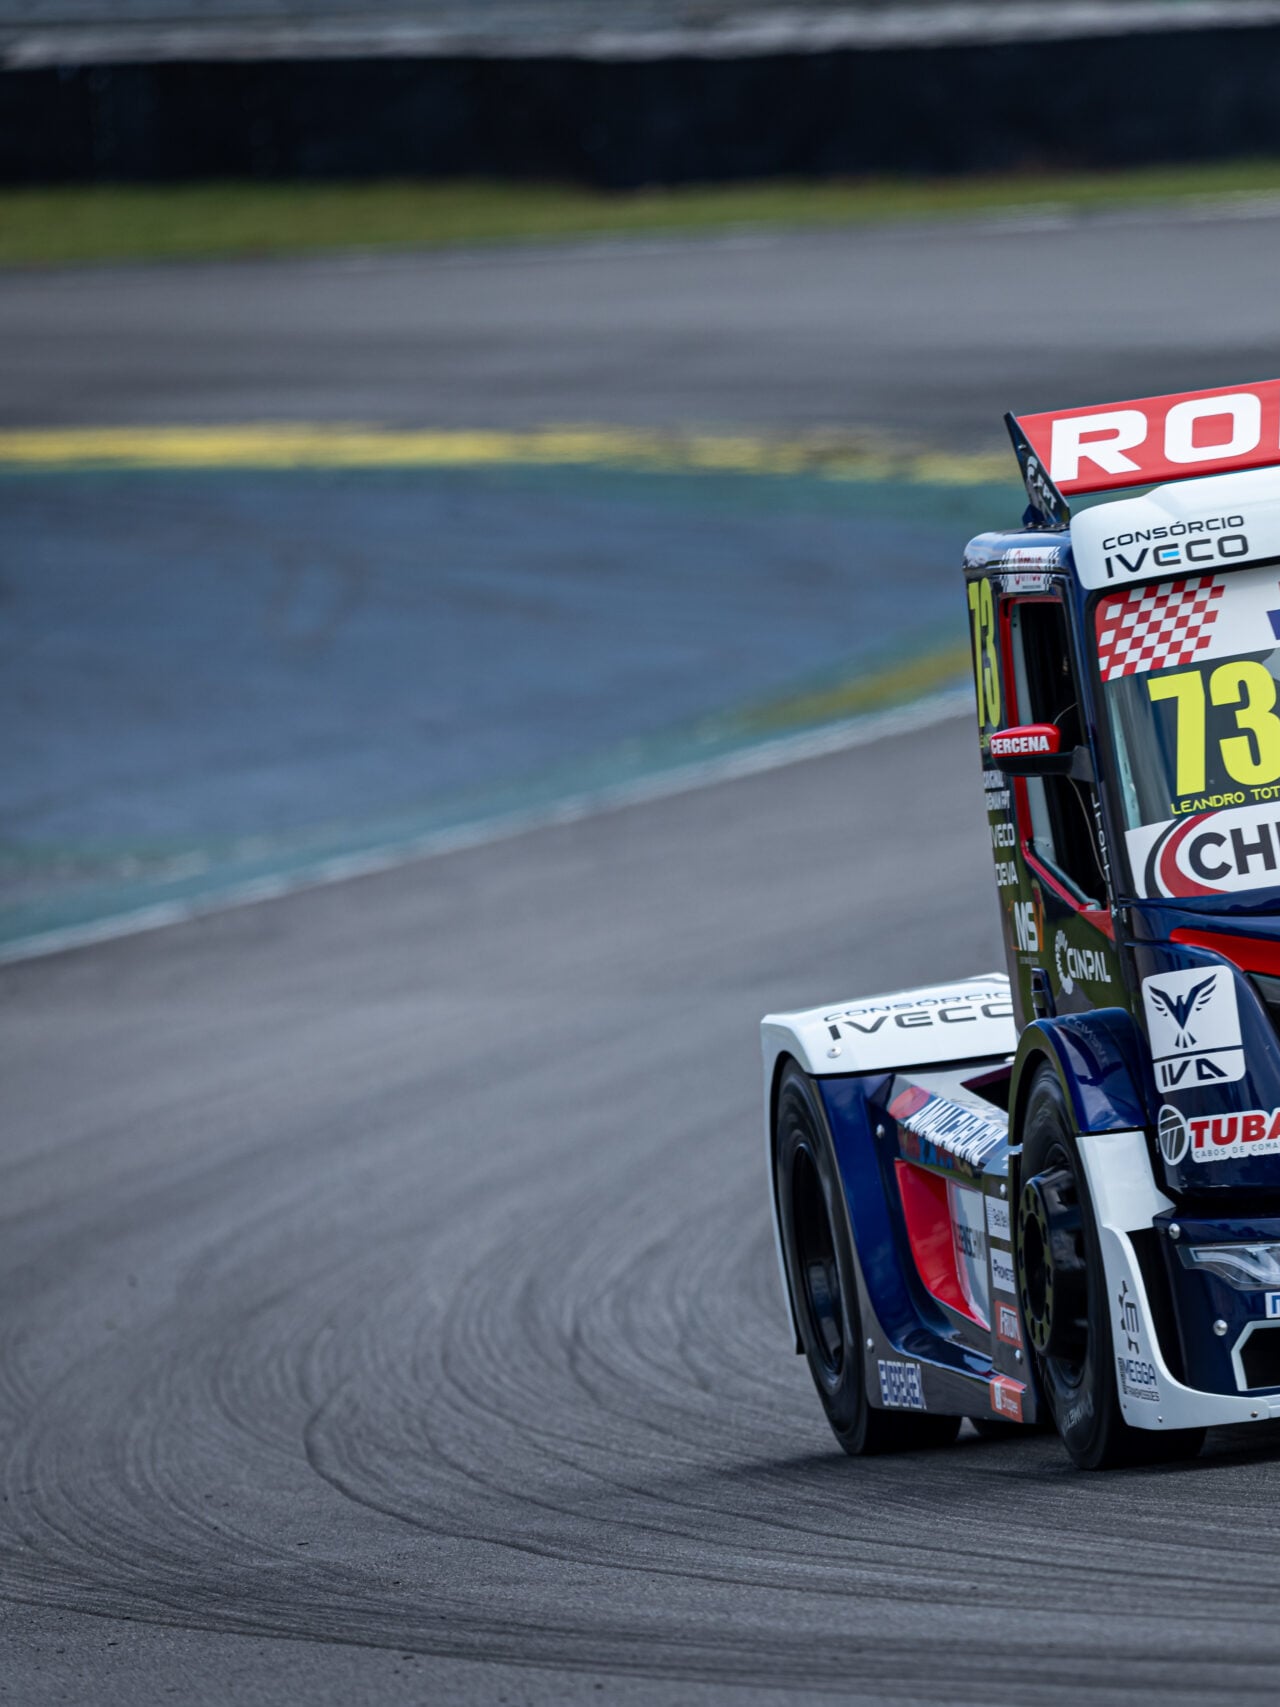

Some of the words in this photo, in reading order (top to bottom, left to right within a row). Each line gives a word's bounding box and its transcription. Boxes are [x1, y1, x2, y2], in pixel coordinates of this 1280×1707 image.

[1102, 514, 1245, 550] CONSÓRCIO
[1105, 534, 1249, 578] IVECO
[968, 577, 1000, 728] 73
[990, 735, 1050, 755] CERCENA
[1170, 791, 1246, 815] LEANDRO
[1066, 947, 1112, 983] CINPAL
[828, 1002, 1013, 1041] IVECO
[1161, 1057, 1228, 1087] IVA
[1195, 1147, 1226, 1158] CABOS
[1232, 1145, 1245, 1155] DE
